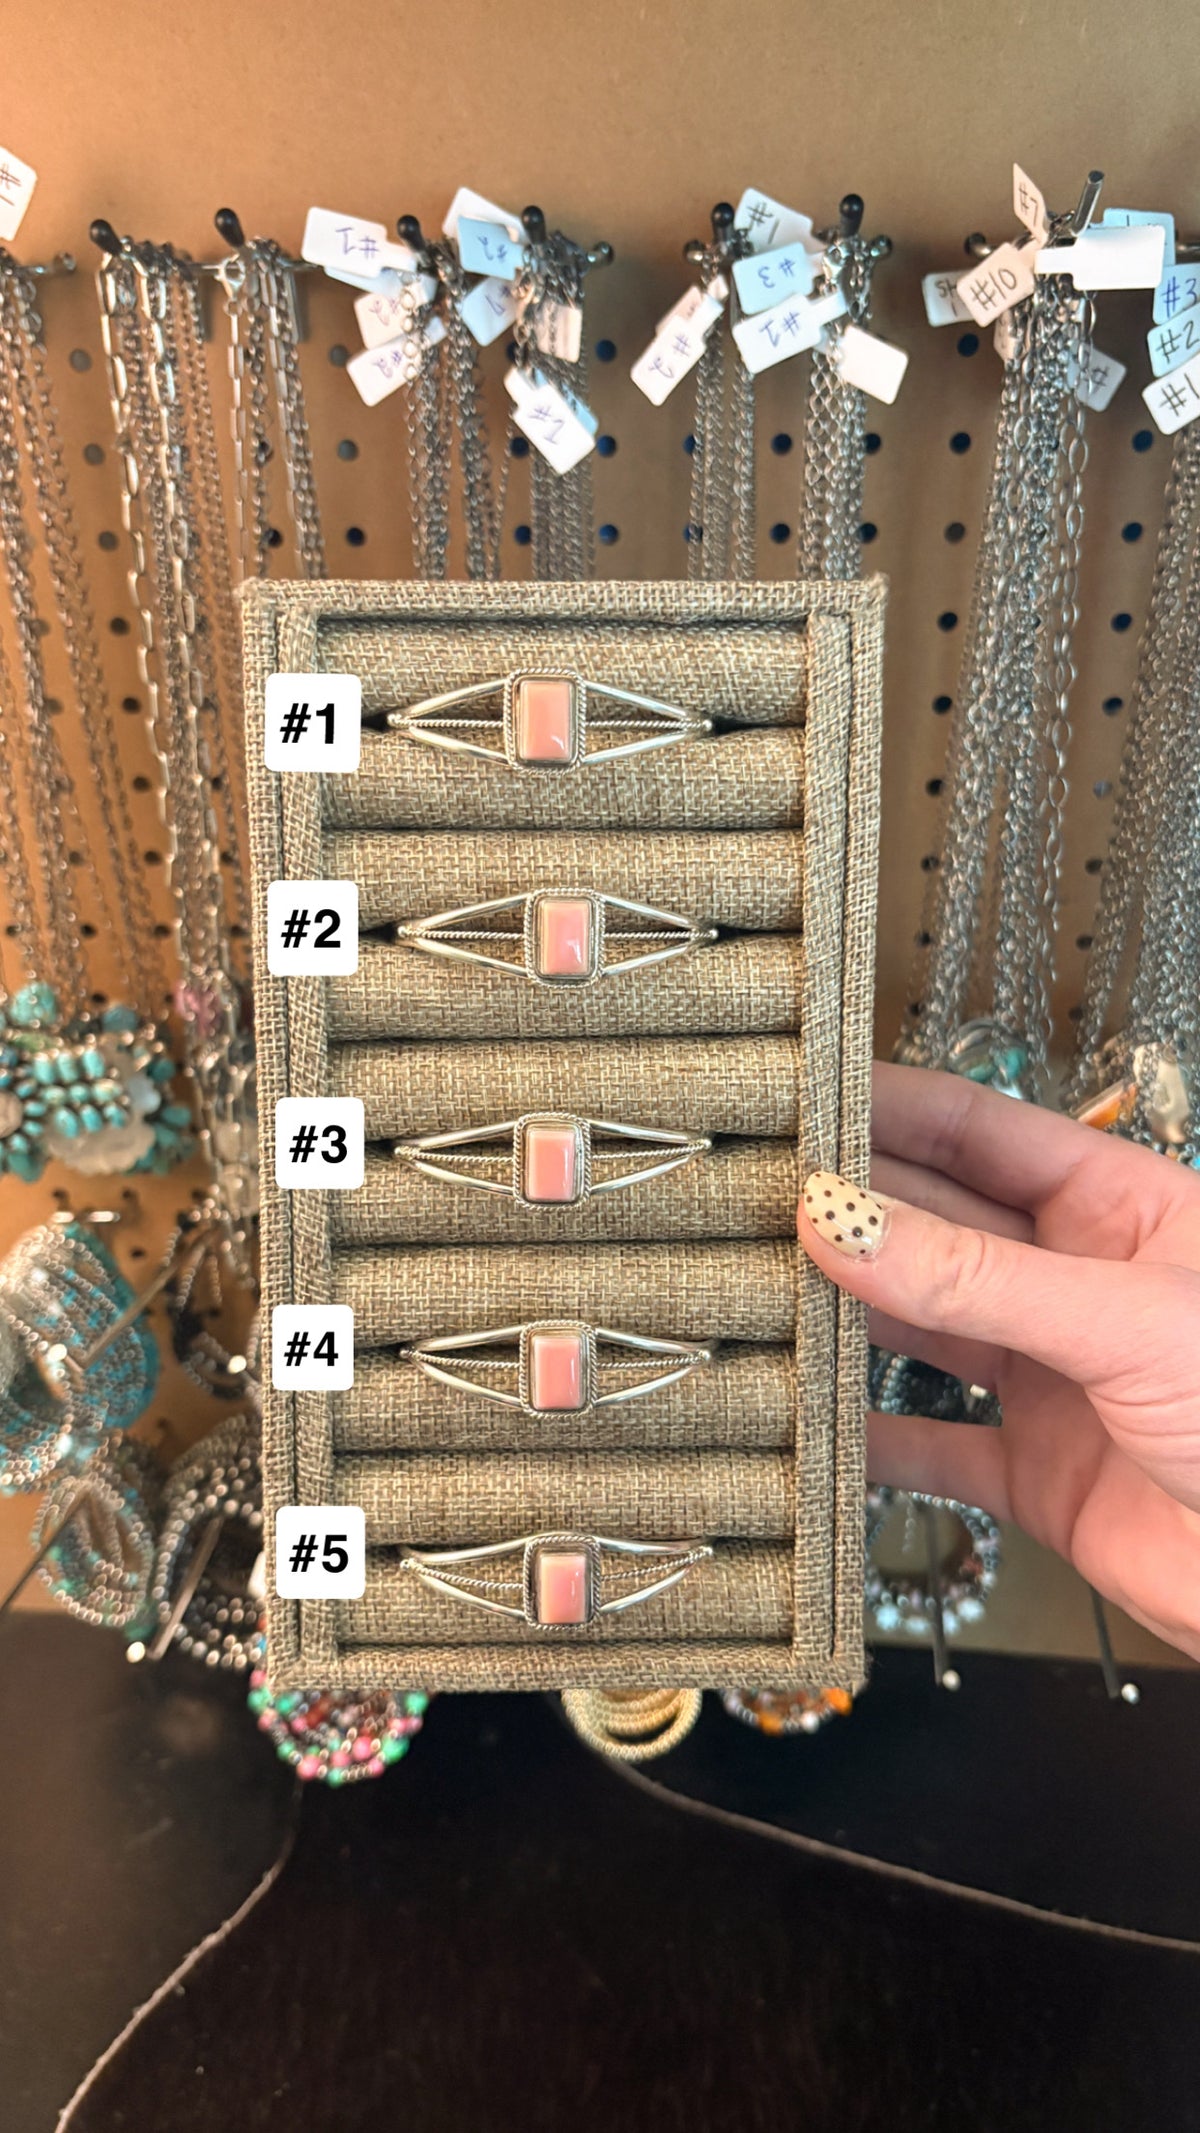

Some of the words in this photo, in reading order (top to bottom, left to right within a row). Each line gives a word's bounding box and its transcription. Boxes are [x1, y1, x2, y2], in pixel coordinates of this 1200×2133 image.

[335, 226, 380, 259] #1
[756, 257, 797, 290] #3
[970, 269, 1018, 312] #10
[1161, 275, 1198, 318] #3
[758, 311, 801, 349] #1
[1155, 319, 1200, 364] #2
[1159, 372, 1200, 417] #1
[527, 405, 567, 446] #1
